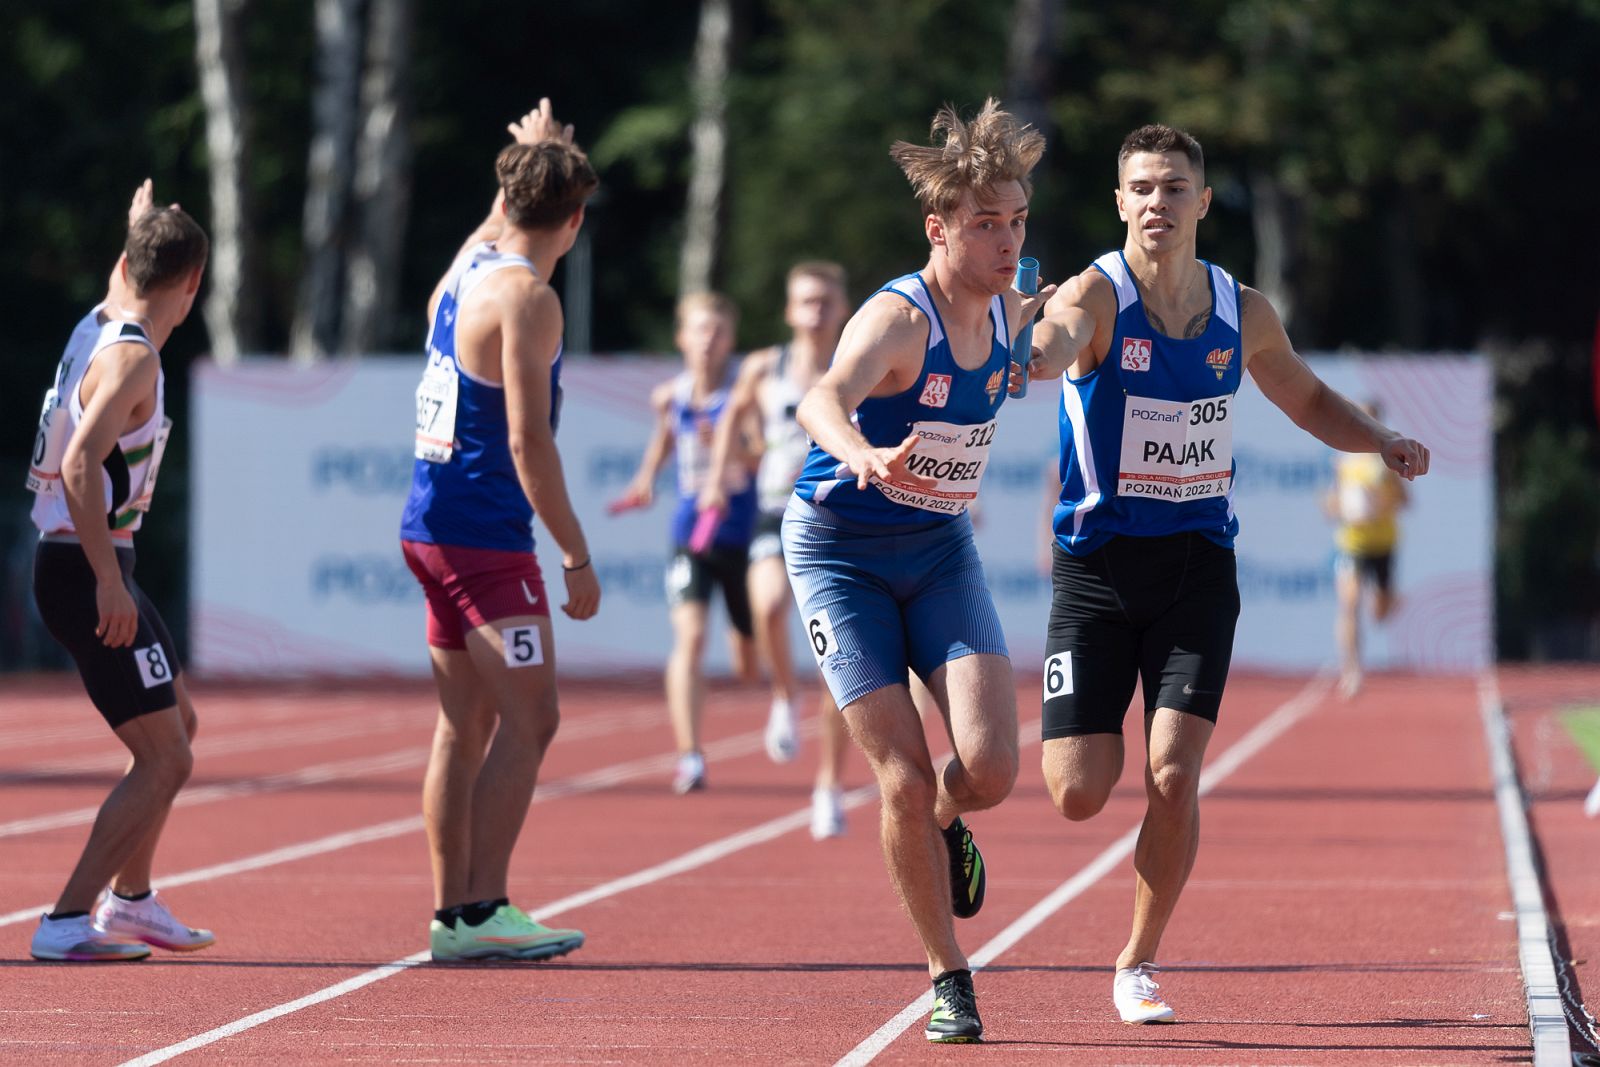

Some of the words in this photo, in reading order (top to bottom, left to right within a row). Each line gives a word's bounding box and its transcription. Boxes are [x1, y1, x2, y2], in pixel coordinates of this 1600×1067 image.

[1190, 399, 1227, 426] 305
[965, 424, 997, 448] 312
[1143, 439, 1215, 467] PAJĄK
[874, 481, 927, 506] POZNAŃ
[928, 499, 956, 512] 2022
[1125, 483, 1183, 498] POZNAŃ
[1185, 484, 1212, 497] 2022
[514, 629, 534, 662] 5
[809, 618, 828, 657] 6
[146, 648, 166, 680] 8
[1046, 656, 1065, 694] 6
